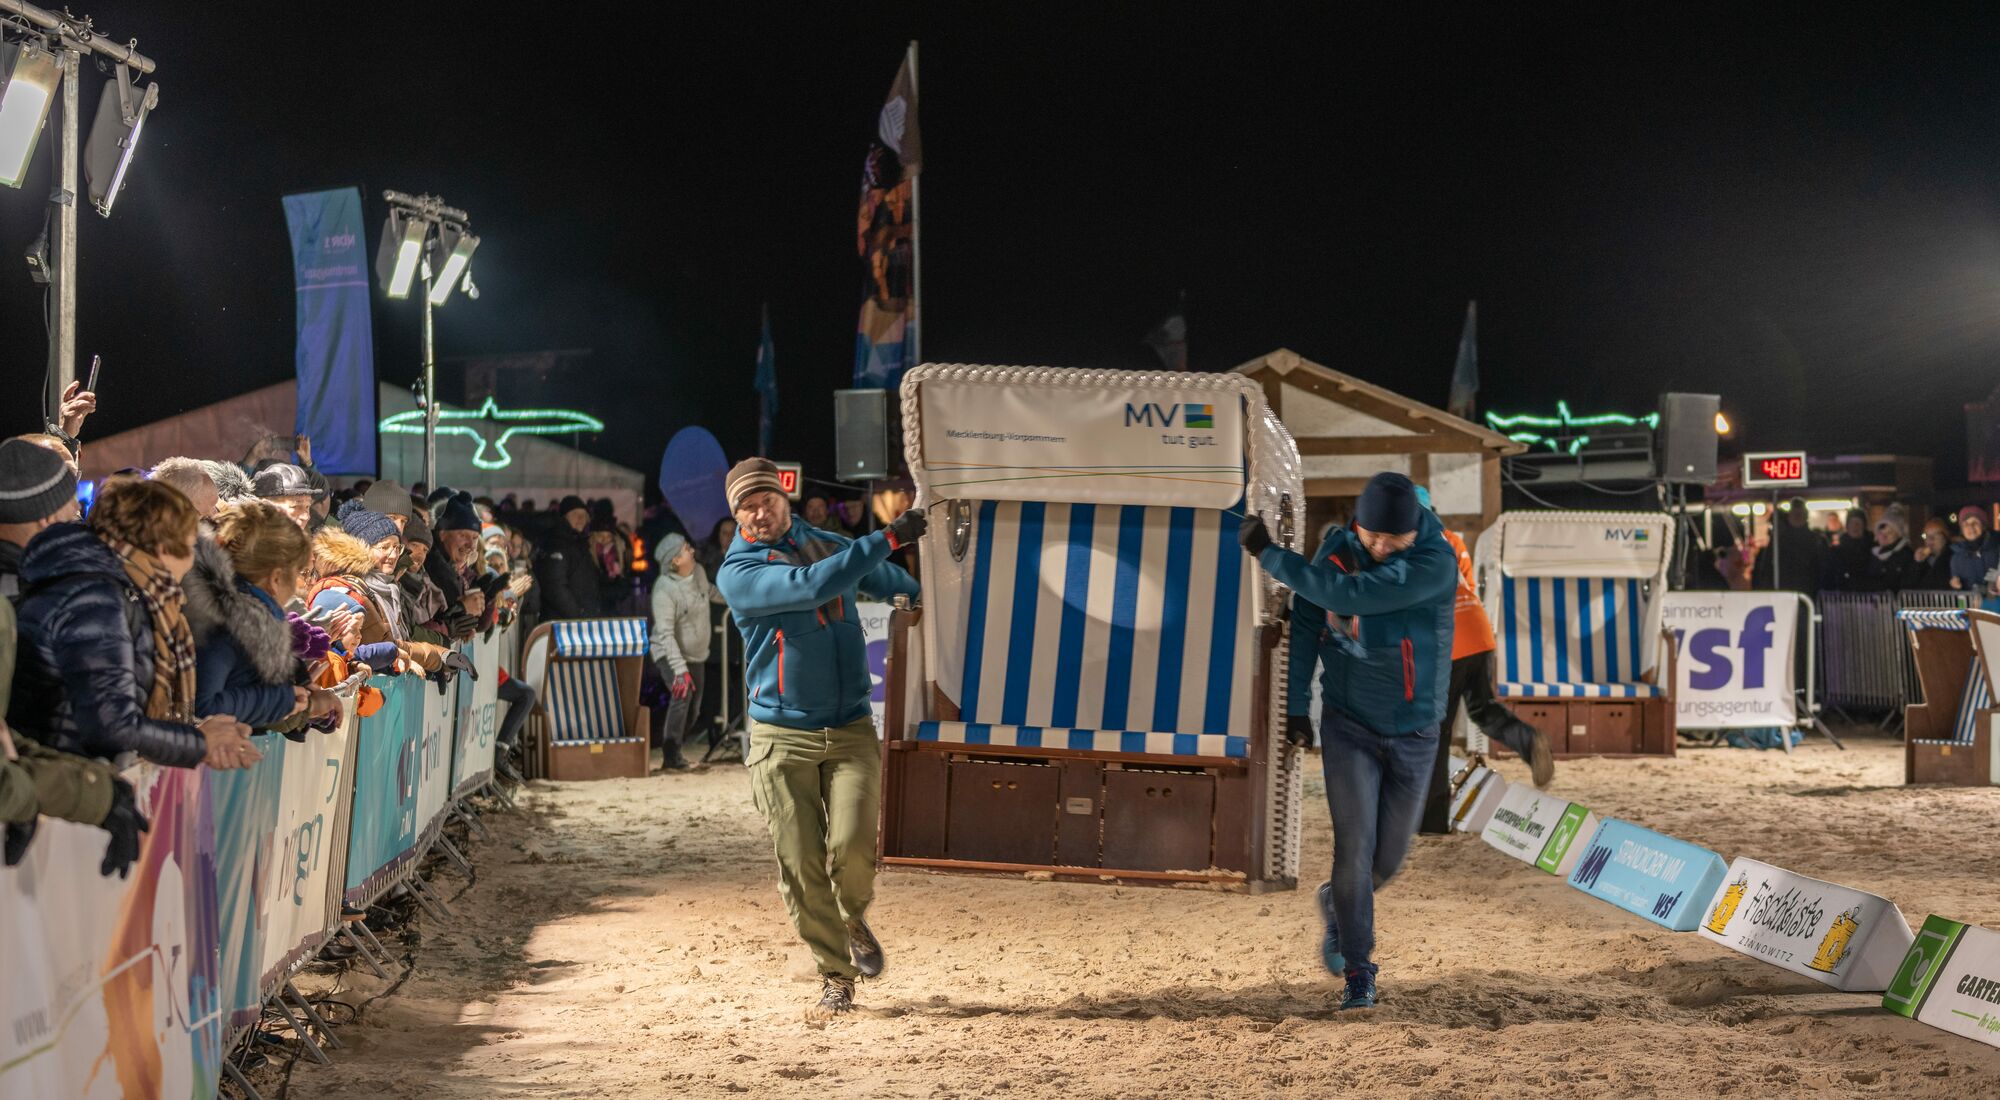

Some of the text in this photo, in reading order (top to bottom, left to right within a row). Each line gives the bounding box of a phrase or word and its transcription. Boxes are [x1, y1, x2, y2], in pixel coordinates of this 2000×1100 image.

[1124, 402, 1180, 428] MV
[945, 429, 1067, 443] Mecklenburg-Vorpommern
[1161, 434, 1218, 449] tut gut.
[1763, 458, 1801, 478] 4:00
[1605, 528, 1633, 541] MV
[1651, 890, 1684, 920] wsf
[1743, 878, 1825, 940] Fischkiste
[1738, 935, 1794, 963] ZINNOWITZ
